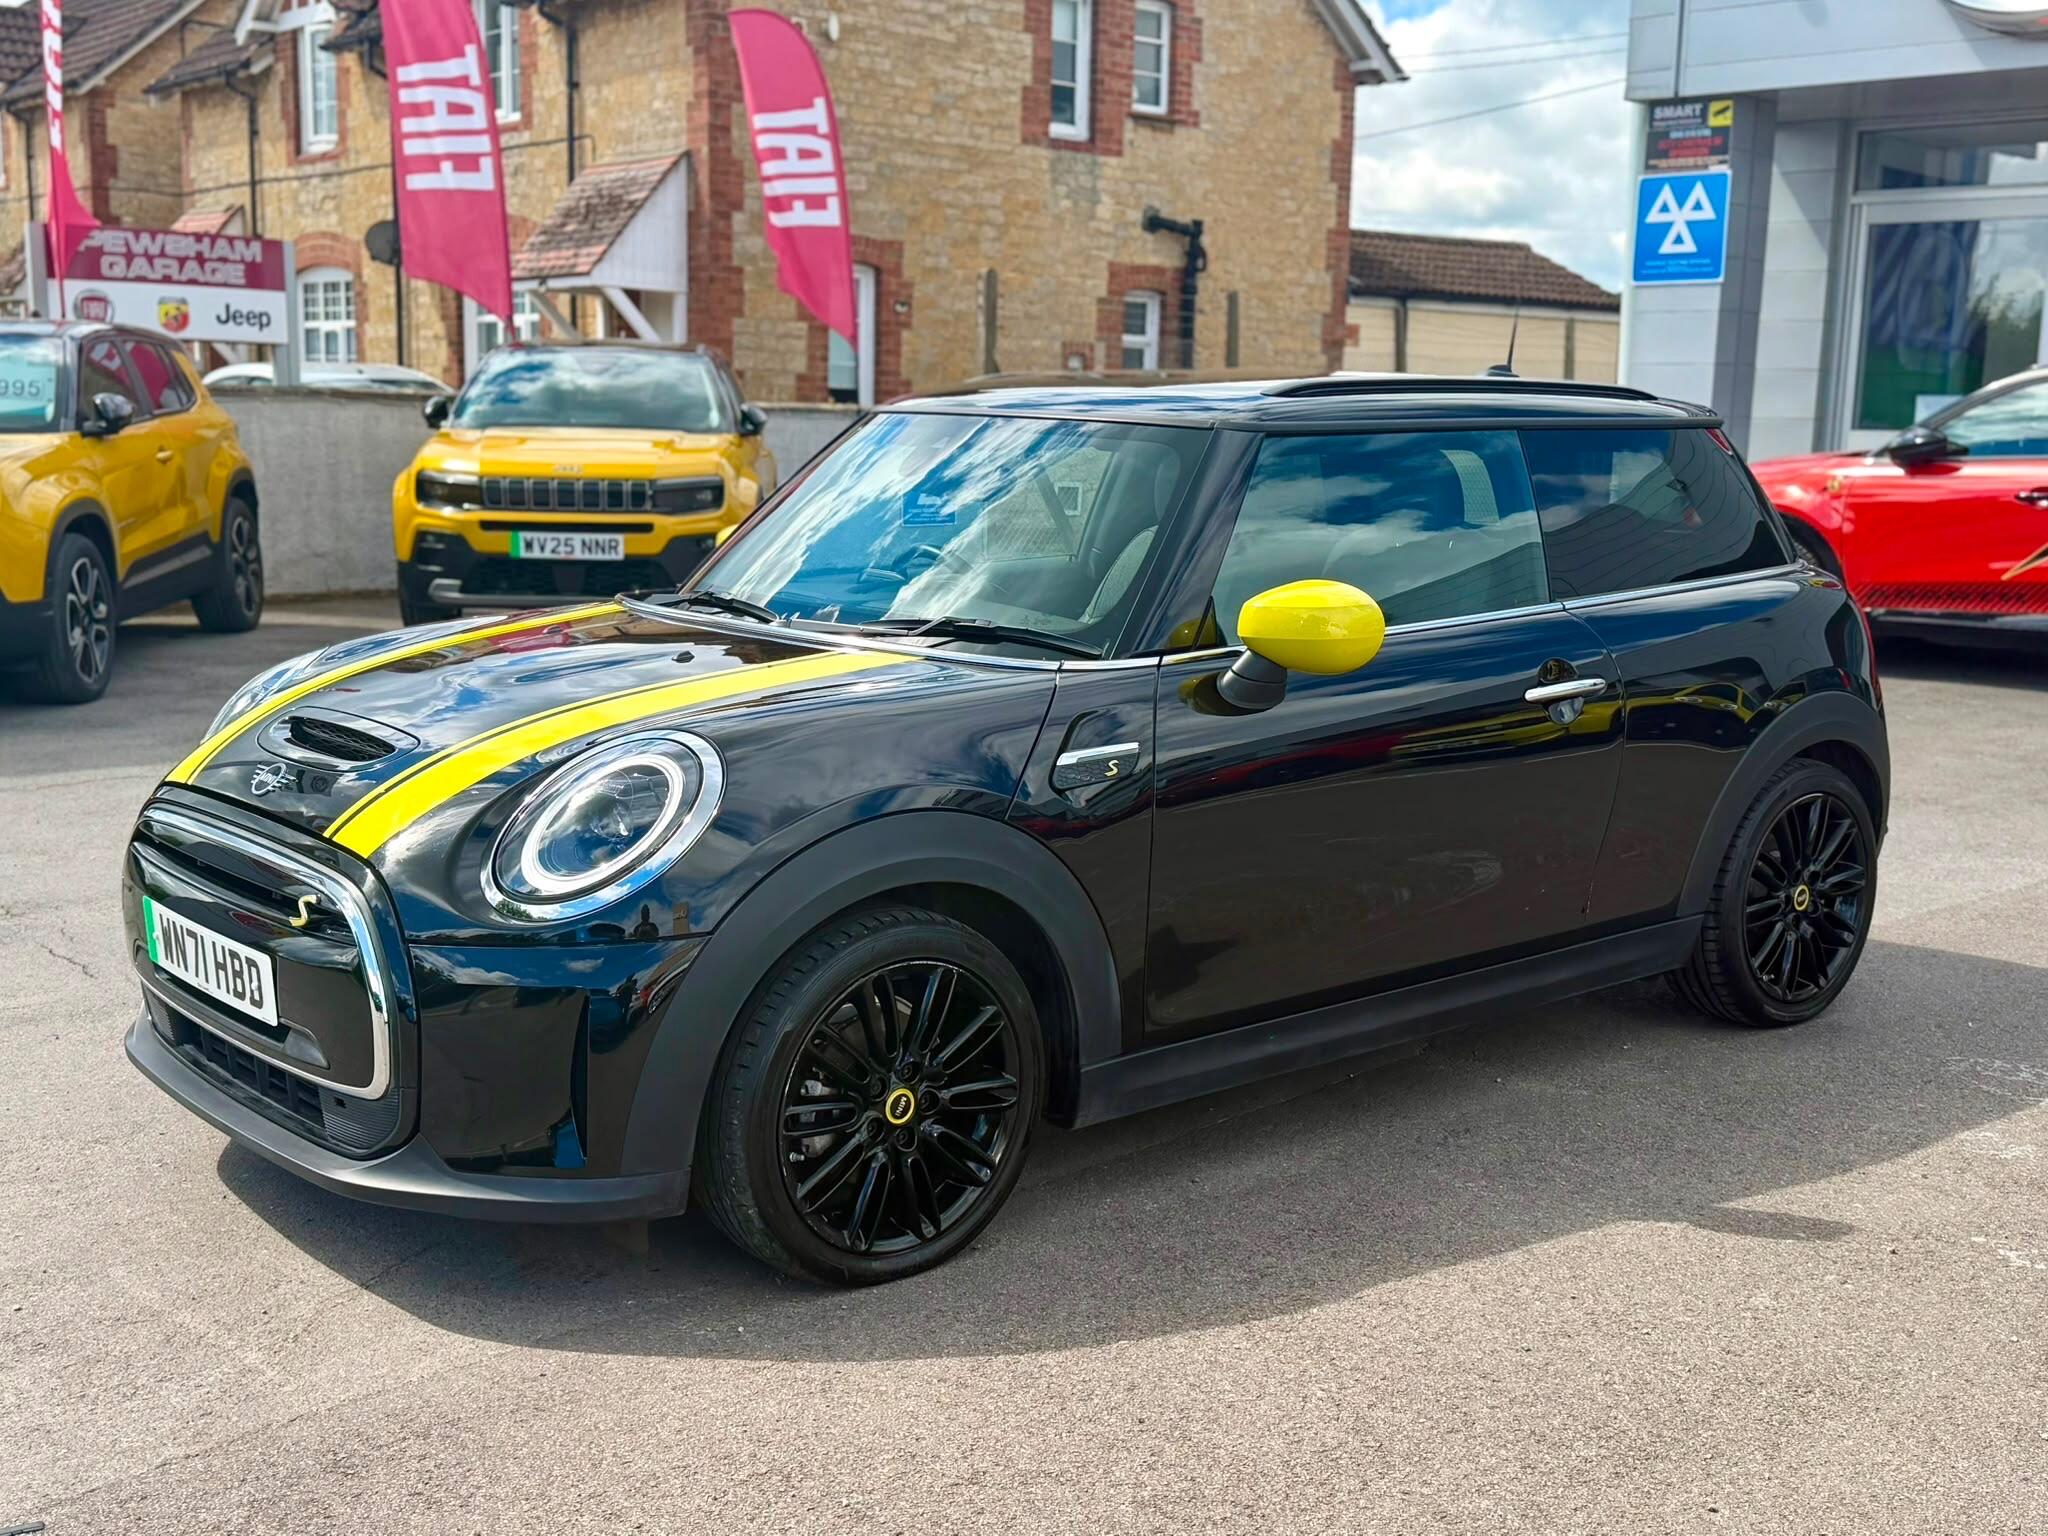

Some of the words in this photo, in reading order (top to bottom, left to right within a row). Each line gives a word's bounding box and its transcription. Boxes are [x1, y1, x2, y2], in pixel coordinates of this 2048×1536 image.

[1653, 103, 1703, 120] SMART
[100, 255, 246, 285] GARAGE
[216, 303, 271, 332] Jeep
[523, 536, 576, 555] WV25
[581, 537, 620, 555] NNR
[159, 913, 210, 985] WN71
[212, 941, 264, 1010] HBD
